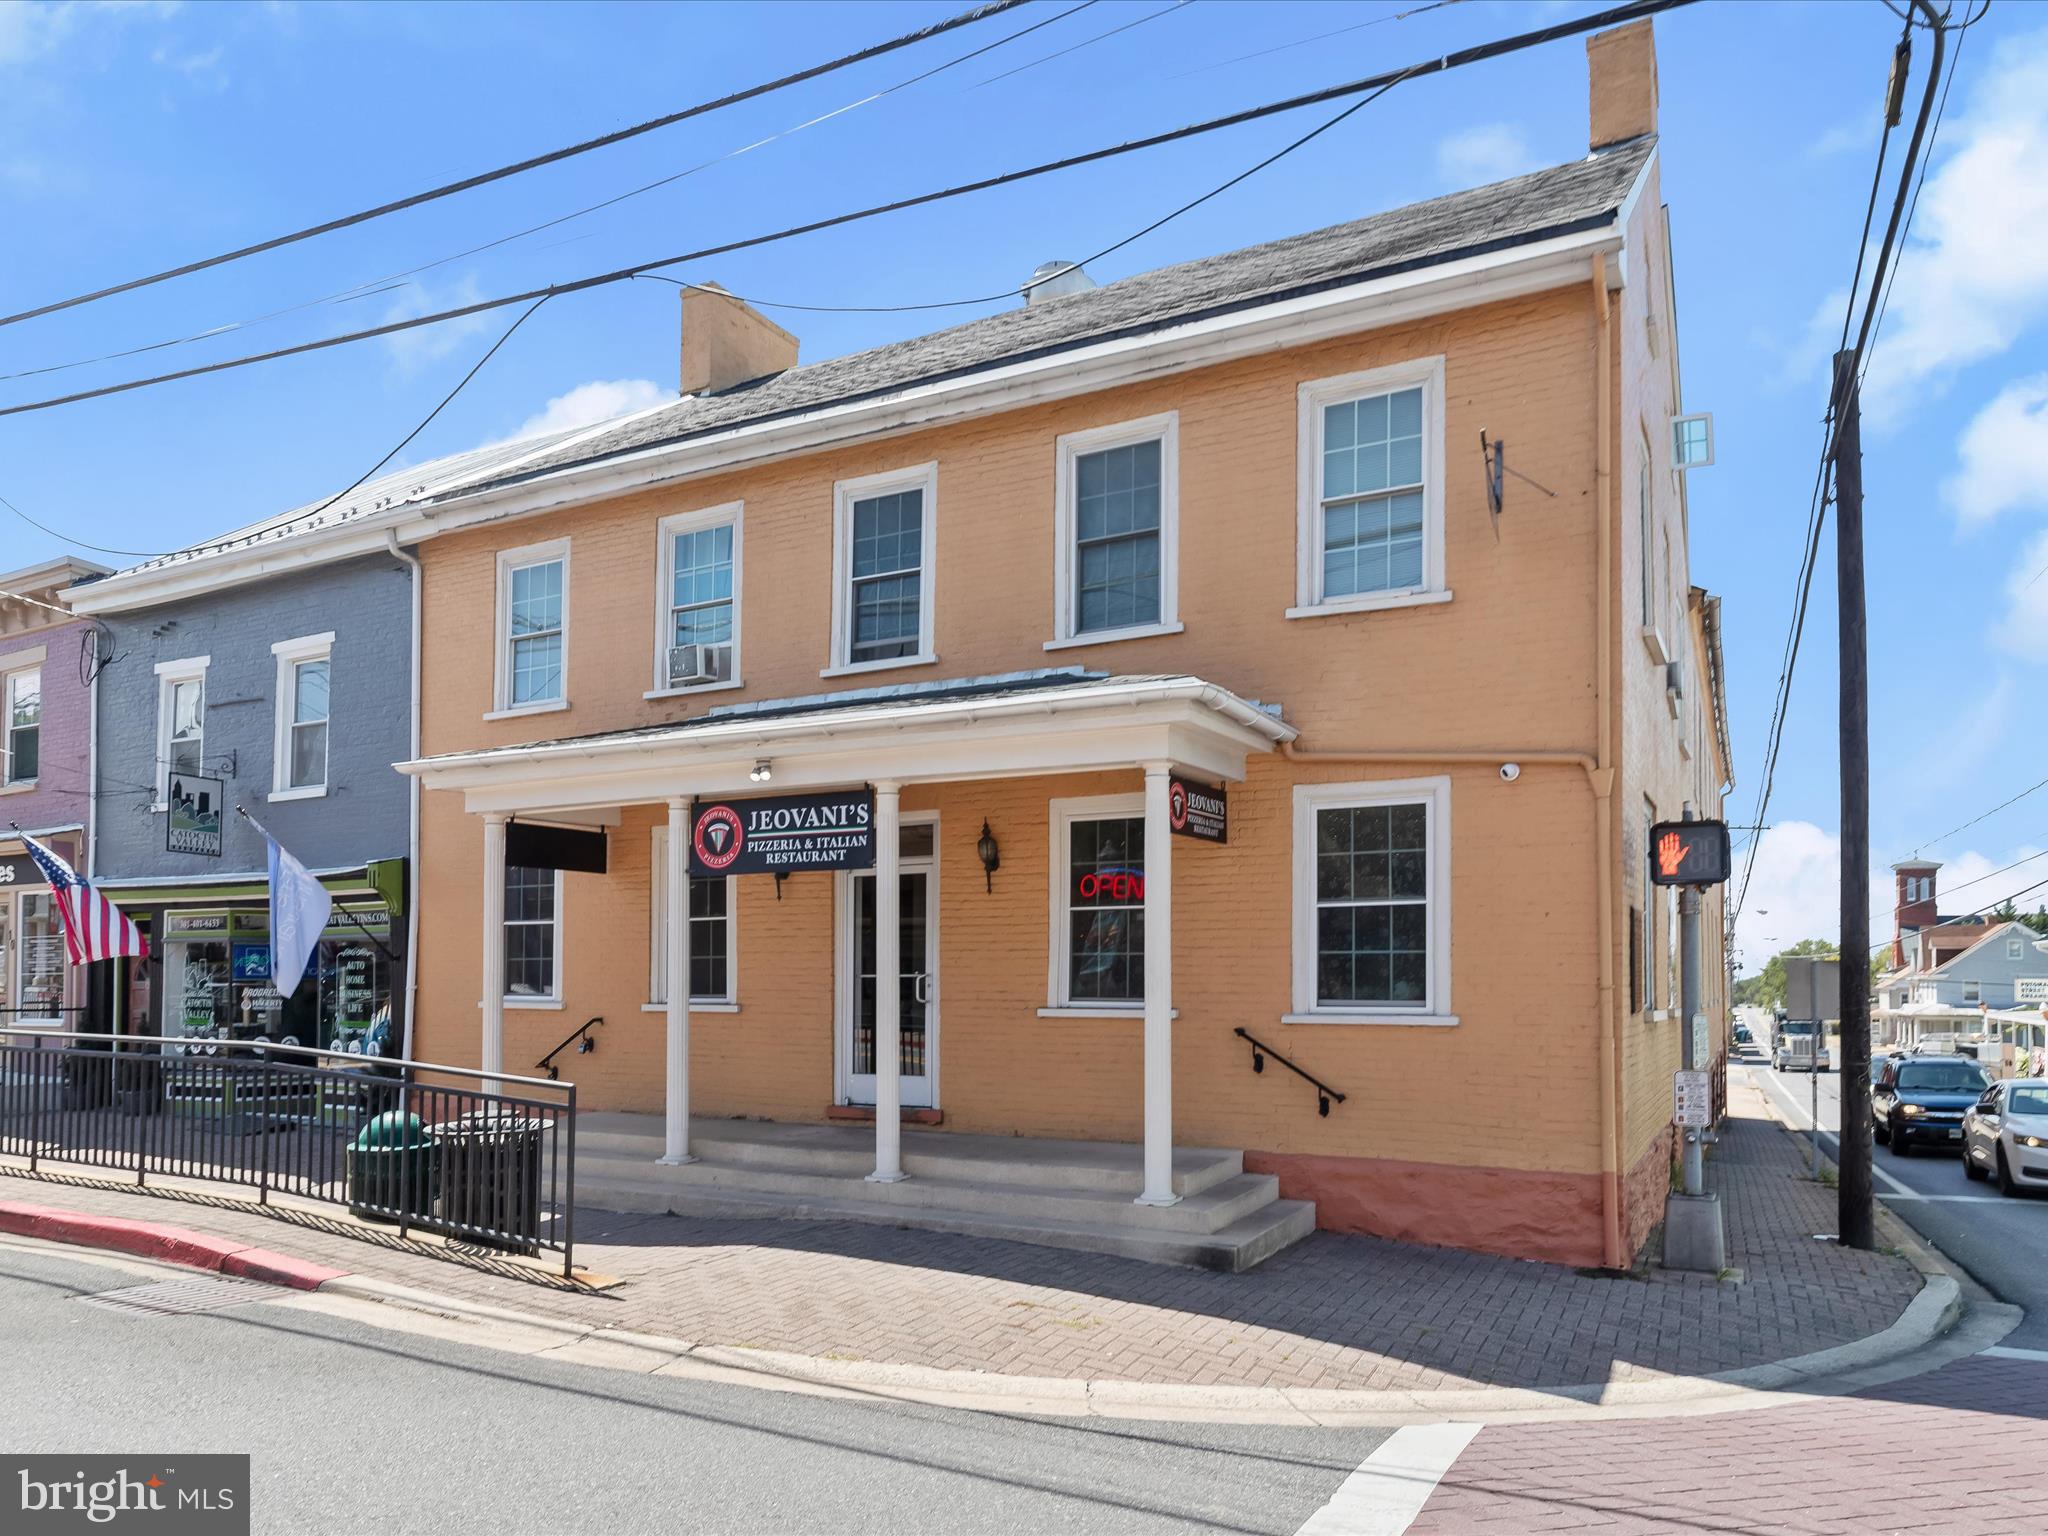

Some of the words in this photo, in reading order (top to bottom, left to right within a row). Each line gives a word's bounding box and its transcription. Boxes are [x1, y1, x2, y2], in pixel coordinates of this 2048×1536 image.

[1187, 792, 1225, 816] JEOVANI'S
[703, 811, 734, 825] JEOVANI'S
[747, 803, 869, 831] JEOVANI'S
[748, 838, 800, 853] PIZZERIA
[804, 838, 813, 850] &
[817, 835, 868, 850] ITALIAN
[703, 852, 735, 865] PIZZERIA
[766, 849, 847, 865] RESTAURANT
[1079, 873, 1145, 899] OPEN
[345, 960, 366, 970] AUTO
[345, 975, 366, 985] HOME
[347, 1003, 364, 1013] LIFE
